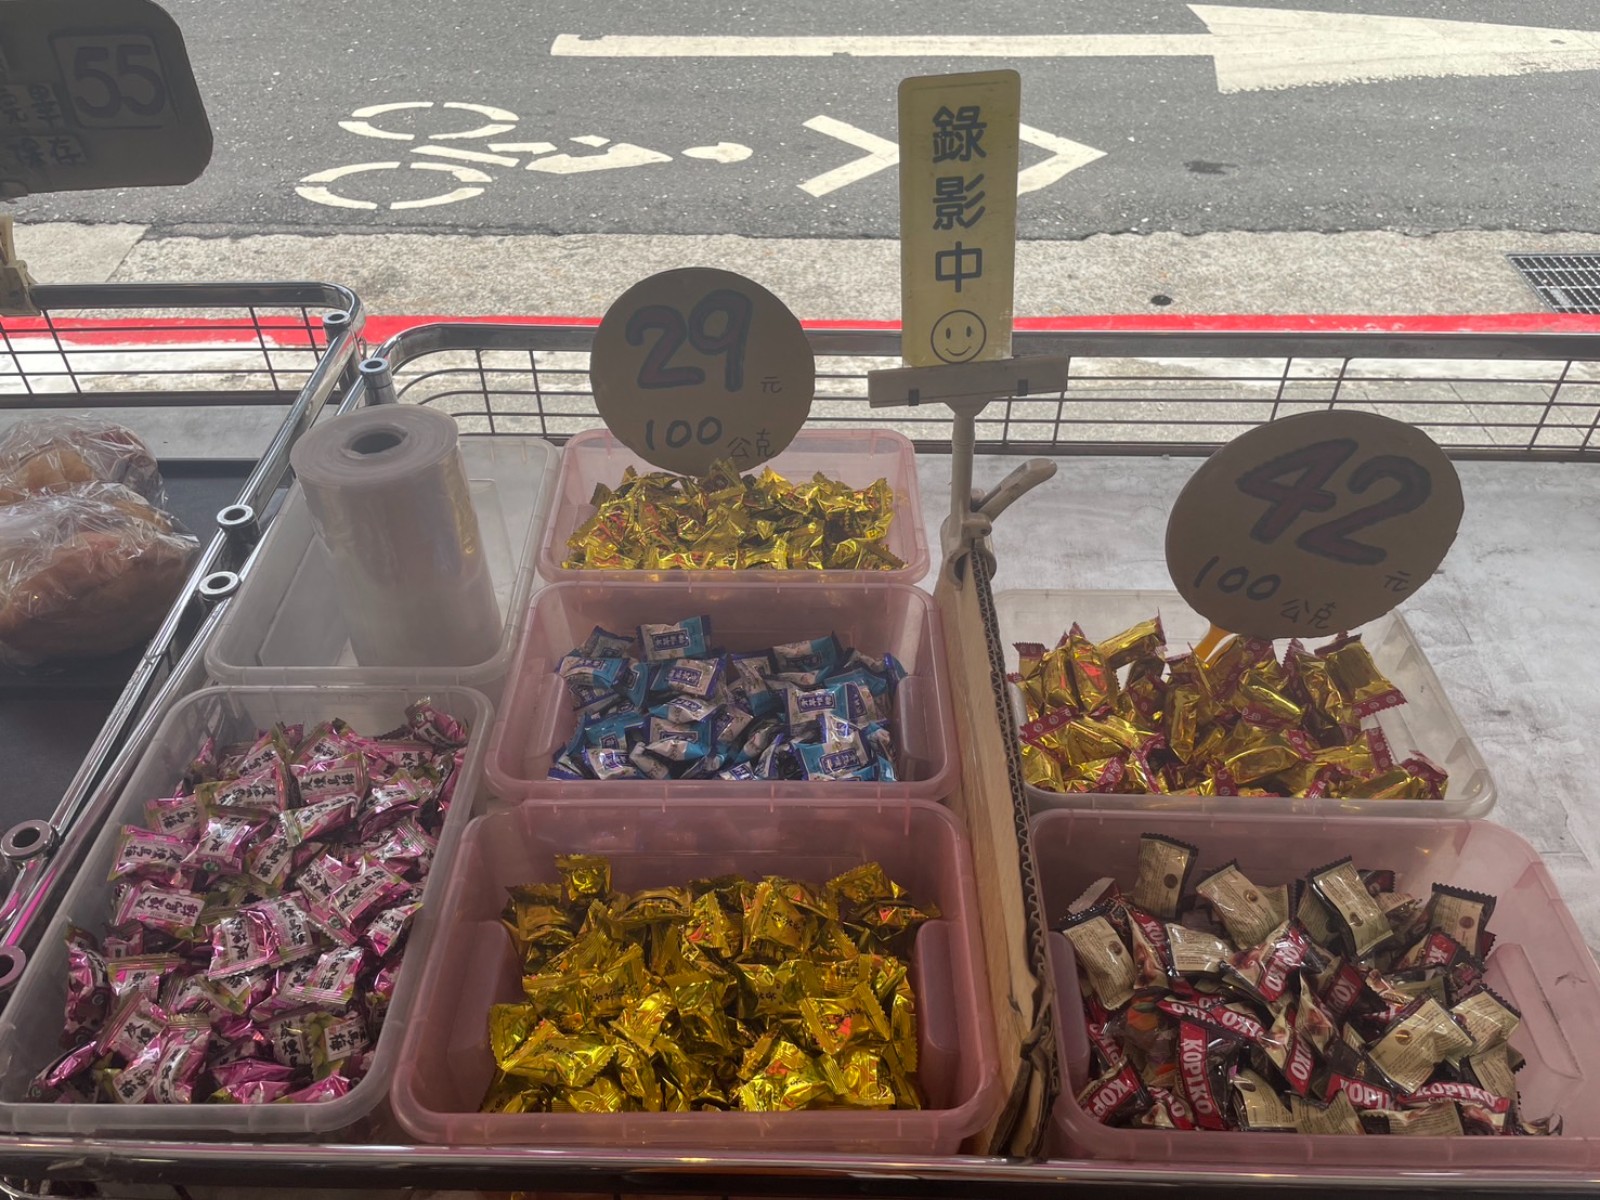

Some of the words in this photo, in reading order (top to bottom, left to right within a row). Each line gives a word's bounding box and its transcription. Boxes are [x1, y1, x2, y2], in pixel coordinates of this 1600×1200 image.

[73, 44, 166, 119] 55
[932, 105, 987, 292] 錄影中
[625, 289, 753, 392] 29
[761, 376, 782, 393] 元
[645, 416, 722, 450] 100
[728, 428, 774, 457] 公克
[1235, 438, 1431, 565] 42
[1384, 571, 1411, 592] 元
[1193, 555, 1281, 600] 100
[1280, 599, 1336, 629] 公克
[1181, 1038, 1213, 1114] KOPIKO
